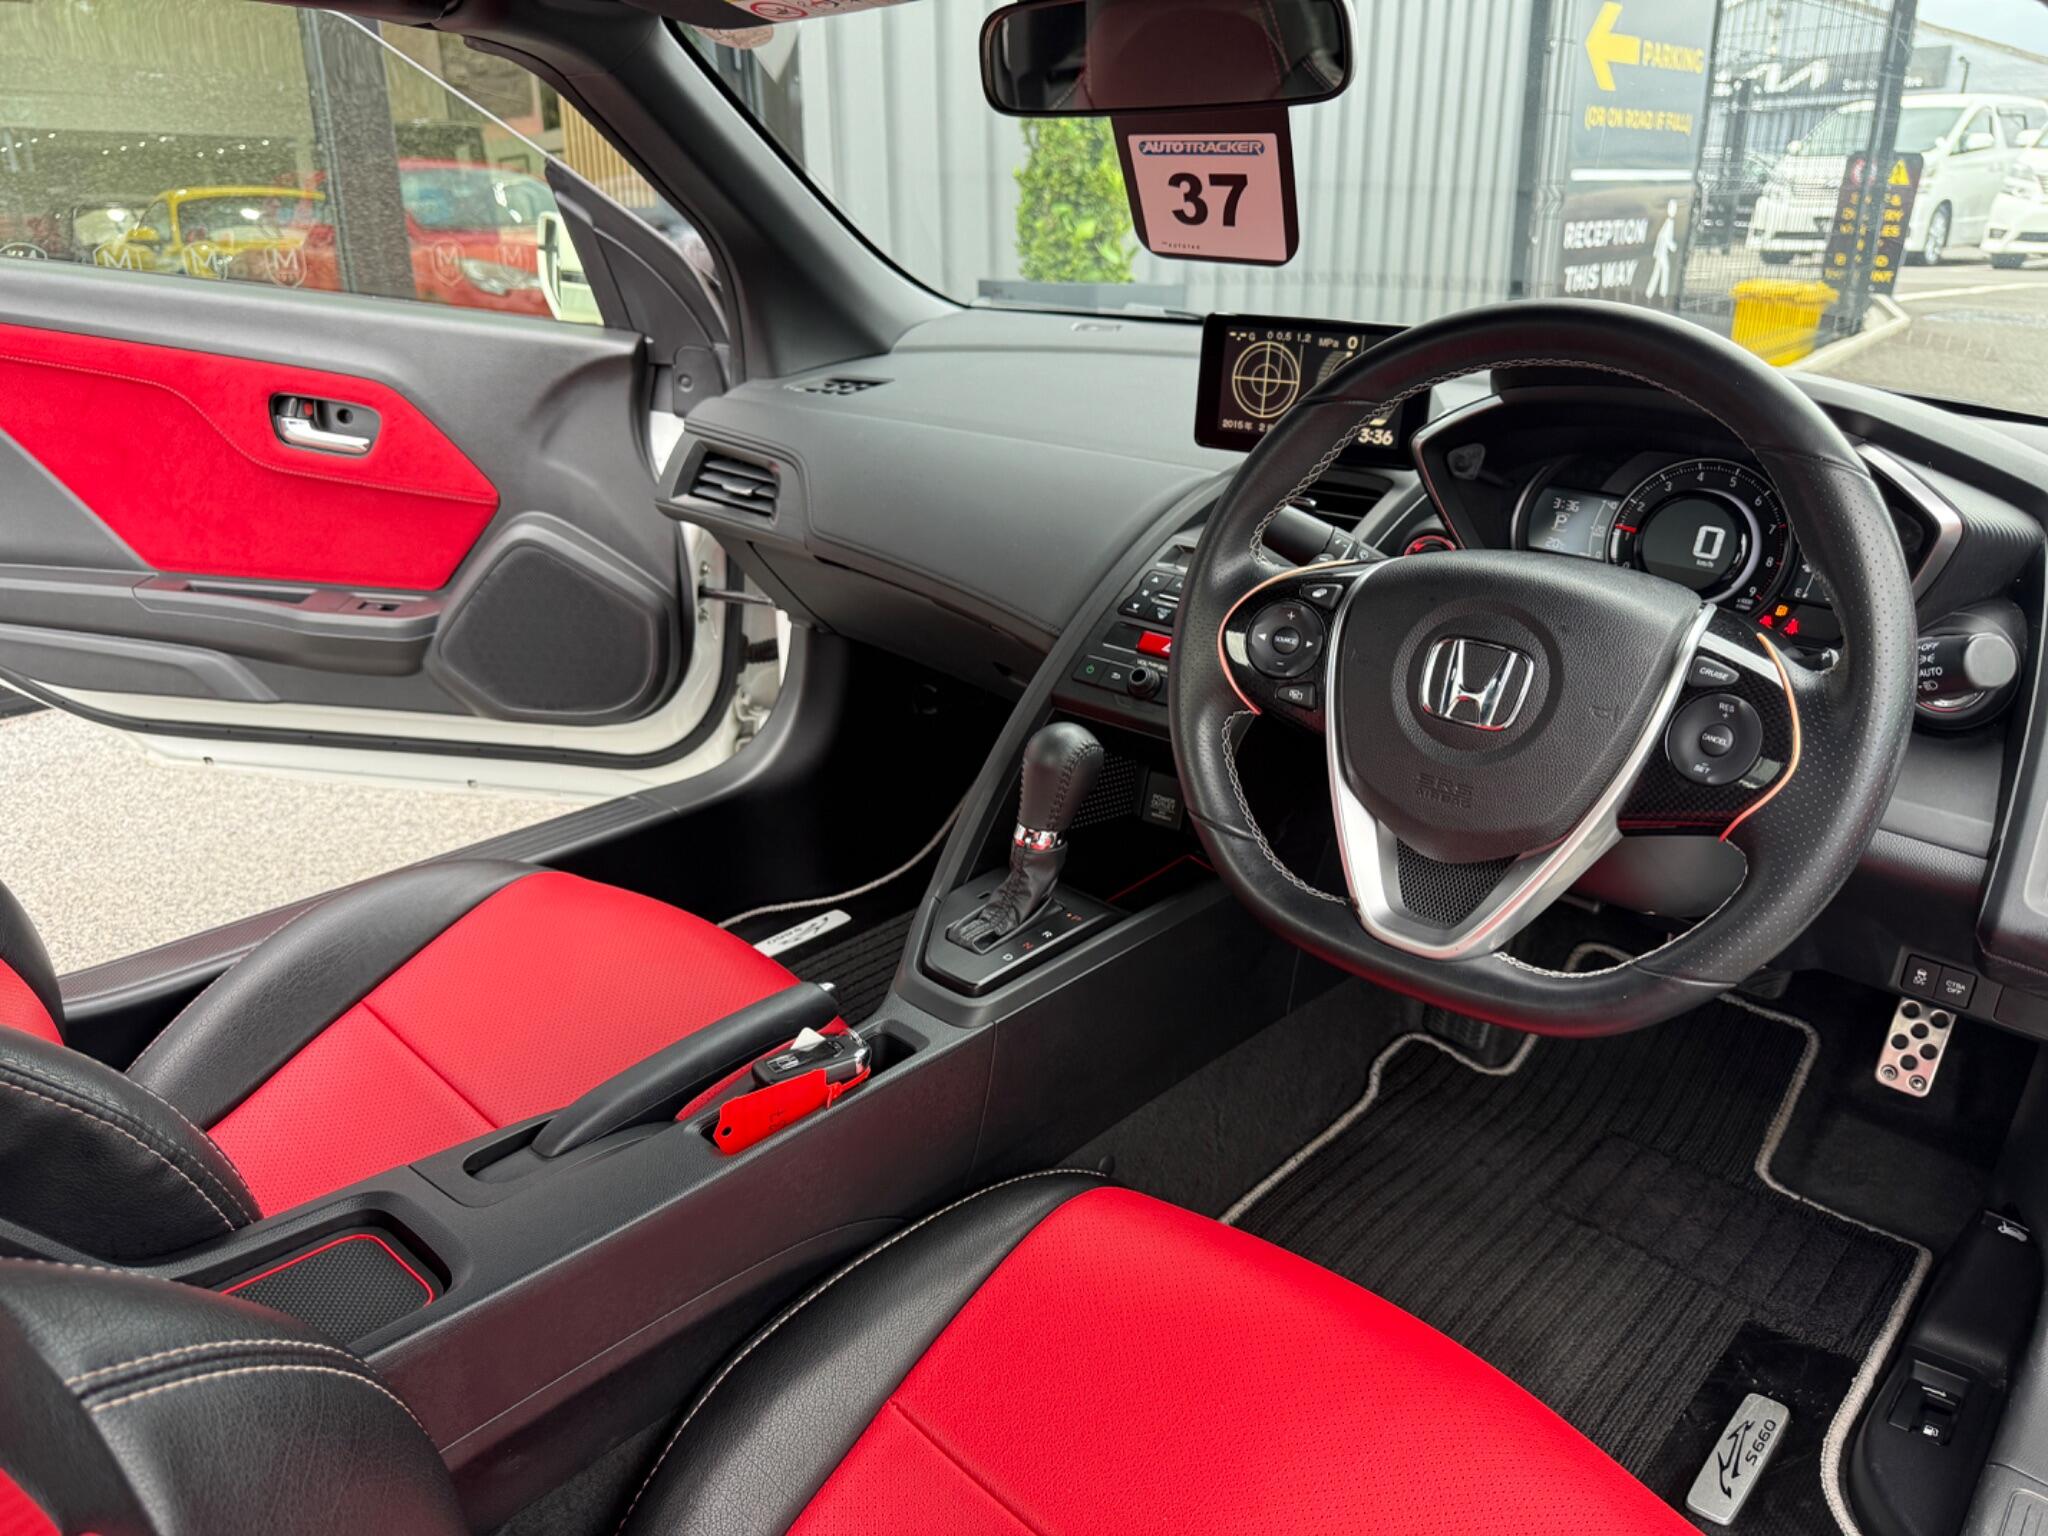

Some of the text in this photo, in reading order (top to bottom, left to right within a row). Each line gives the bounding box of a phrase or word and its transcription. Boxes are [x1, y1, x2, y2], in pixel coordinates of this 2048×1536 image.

[1642, 40, 1704, 74] PARKING
[1607, 106, 1623, 128] ON
[1625, 108, 1653, 130] ROAD
[1142, 141, 1262, 155] AUTOTRACKER
[1168, 172, 1248, 227] 37
[1563, 218, 1648, 250] RECEPTION
[1564, 260, 1639, 293] THIS WAY
[1276, 331, 1292, 341] 0.5
[1318, 335, 1358, 350] MPa 0
[1358, 428, 1393, 446] 3:36
[1697, 472, 1705, 482] 4
[1730, 476, 1737, 488] 5
[1665, 481, 1673, 492] 3
[1637, 501, 1646, 512] 2
[1755, 497, 1763, 507] 6
[1768, 524, 1777, 534] 7
[1693, 525, 1726, 560] 0
[1765, 556, 1774, 567] 8
[1749, 586, 1757, 597] 9
[1699, 666, 1729, 681] CRUISE
[1919, 666, 1943, 677] AUTO
[1719, 702, 1734, 712] RES
[1702, 733, 1728, 745] CANCEL
[1694, 764, 1710, 773] SET
[1745, 1419, 1777, 1466] S660
